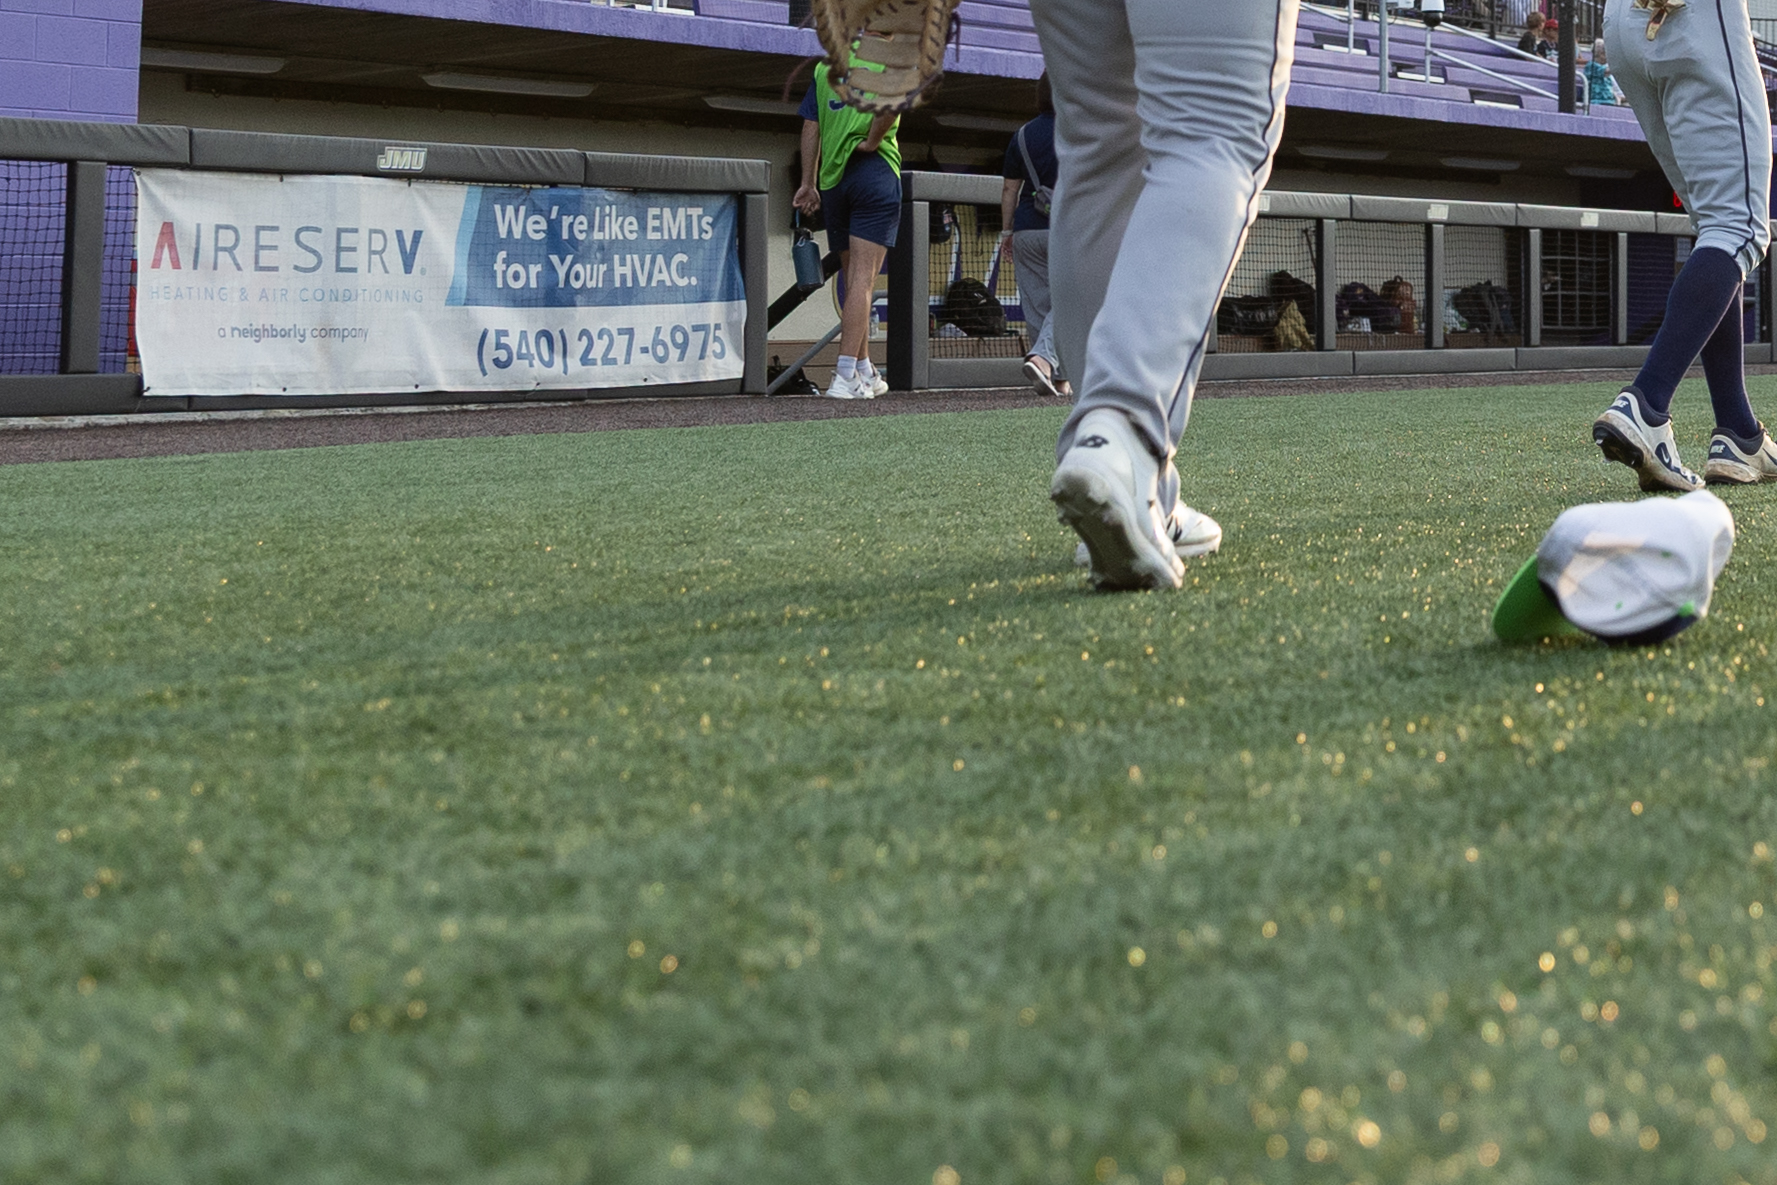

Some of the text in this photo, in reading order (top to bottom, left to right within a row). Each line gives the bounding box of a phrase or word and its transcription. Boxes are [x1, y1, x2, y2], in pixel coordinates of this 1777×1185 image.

[376, 146, 428, 173] JMU
[592, 205, 639, 240] Like
[646, 207, 714, 240] EMTs
[493, 250, 698, 289] for Your HVAC.
[149, 285, 424, 304] HEATING & AIR CONDITIONING
[217, 322, 370, 344] a neighborly company
[477, 322, 727, 378] (540) 227-6975
